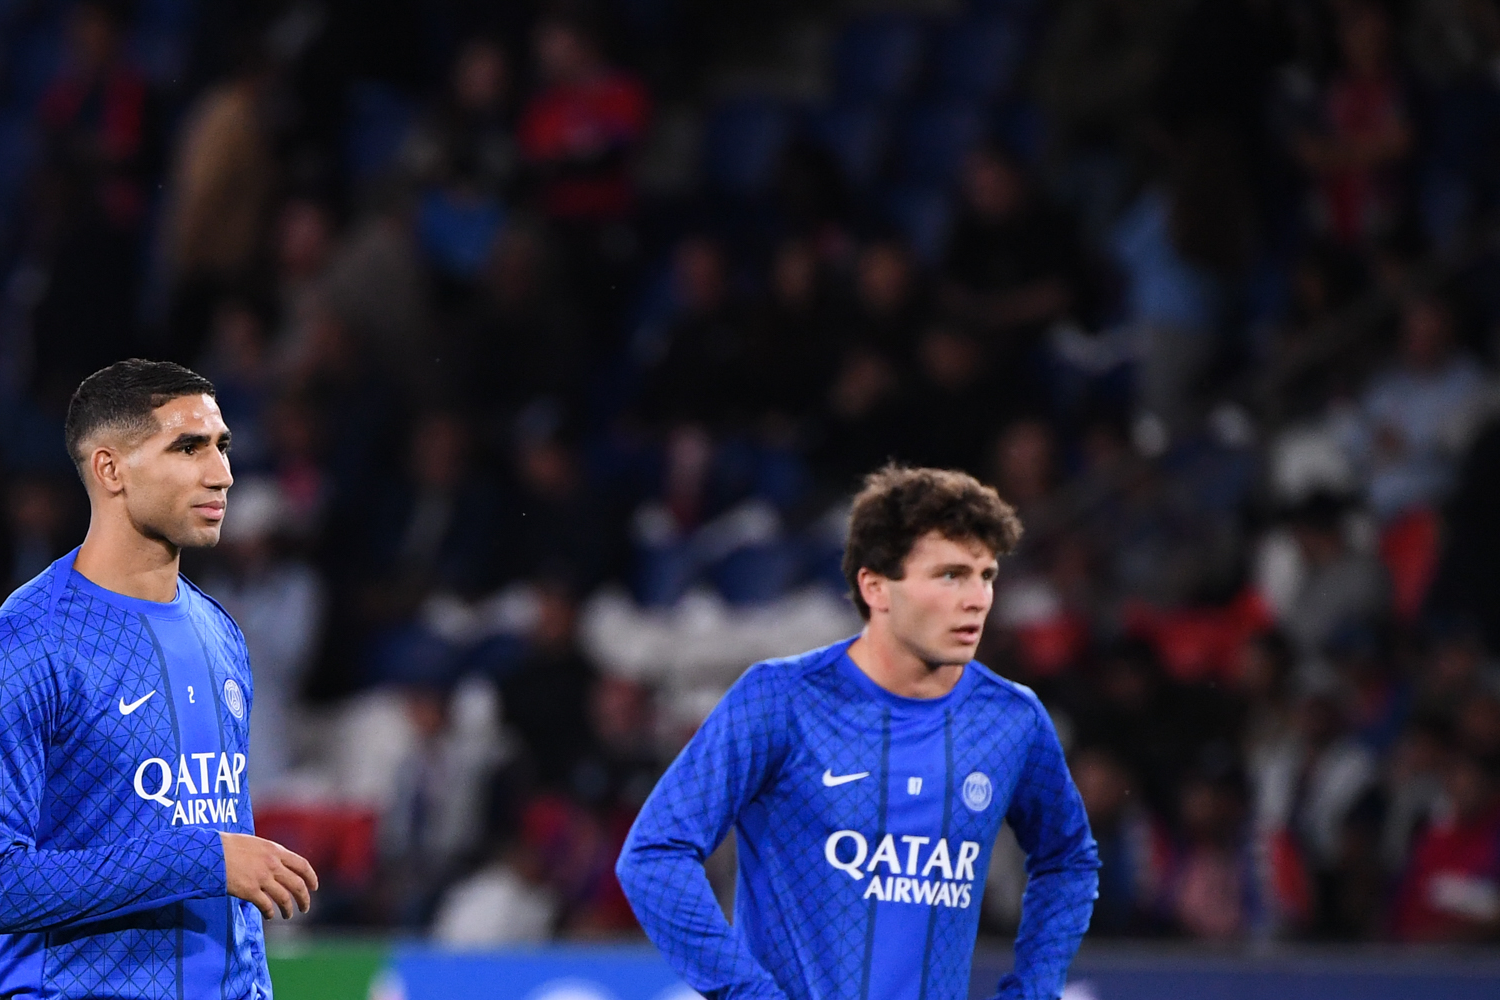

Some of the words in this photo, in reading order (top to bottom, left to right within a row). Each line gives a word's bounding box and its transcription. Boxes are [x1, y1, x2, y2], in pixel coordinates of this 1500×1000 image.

[187, 685, 196, 704] 2
[171, 798, 238, 826] AIRWA
[824, 829, 981, 881] QATAR
[862, 875, 973, 909] AIRWAYS
